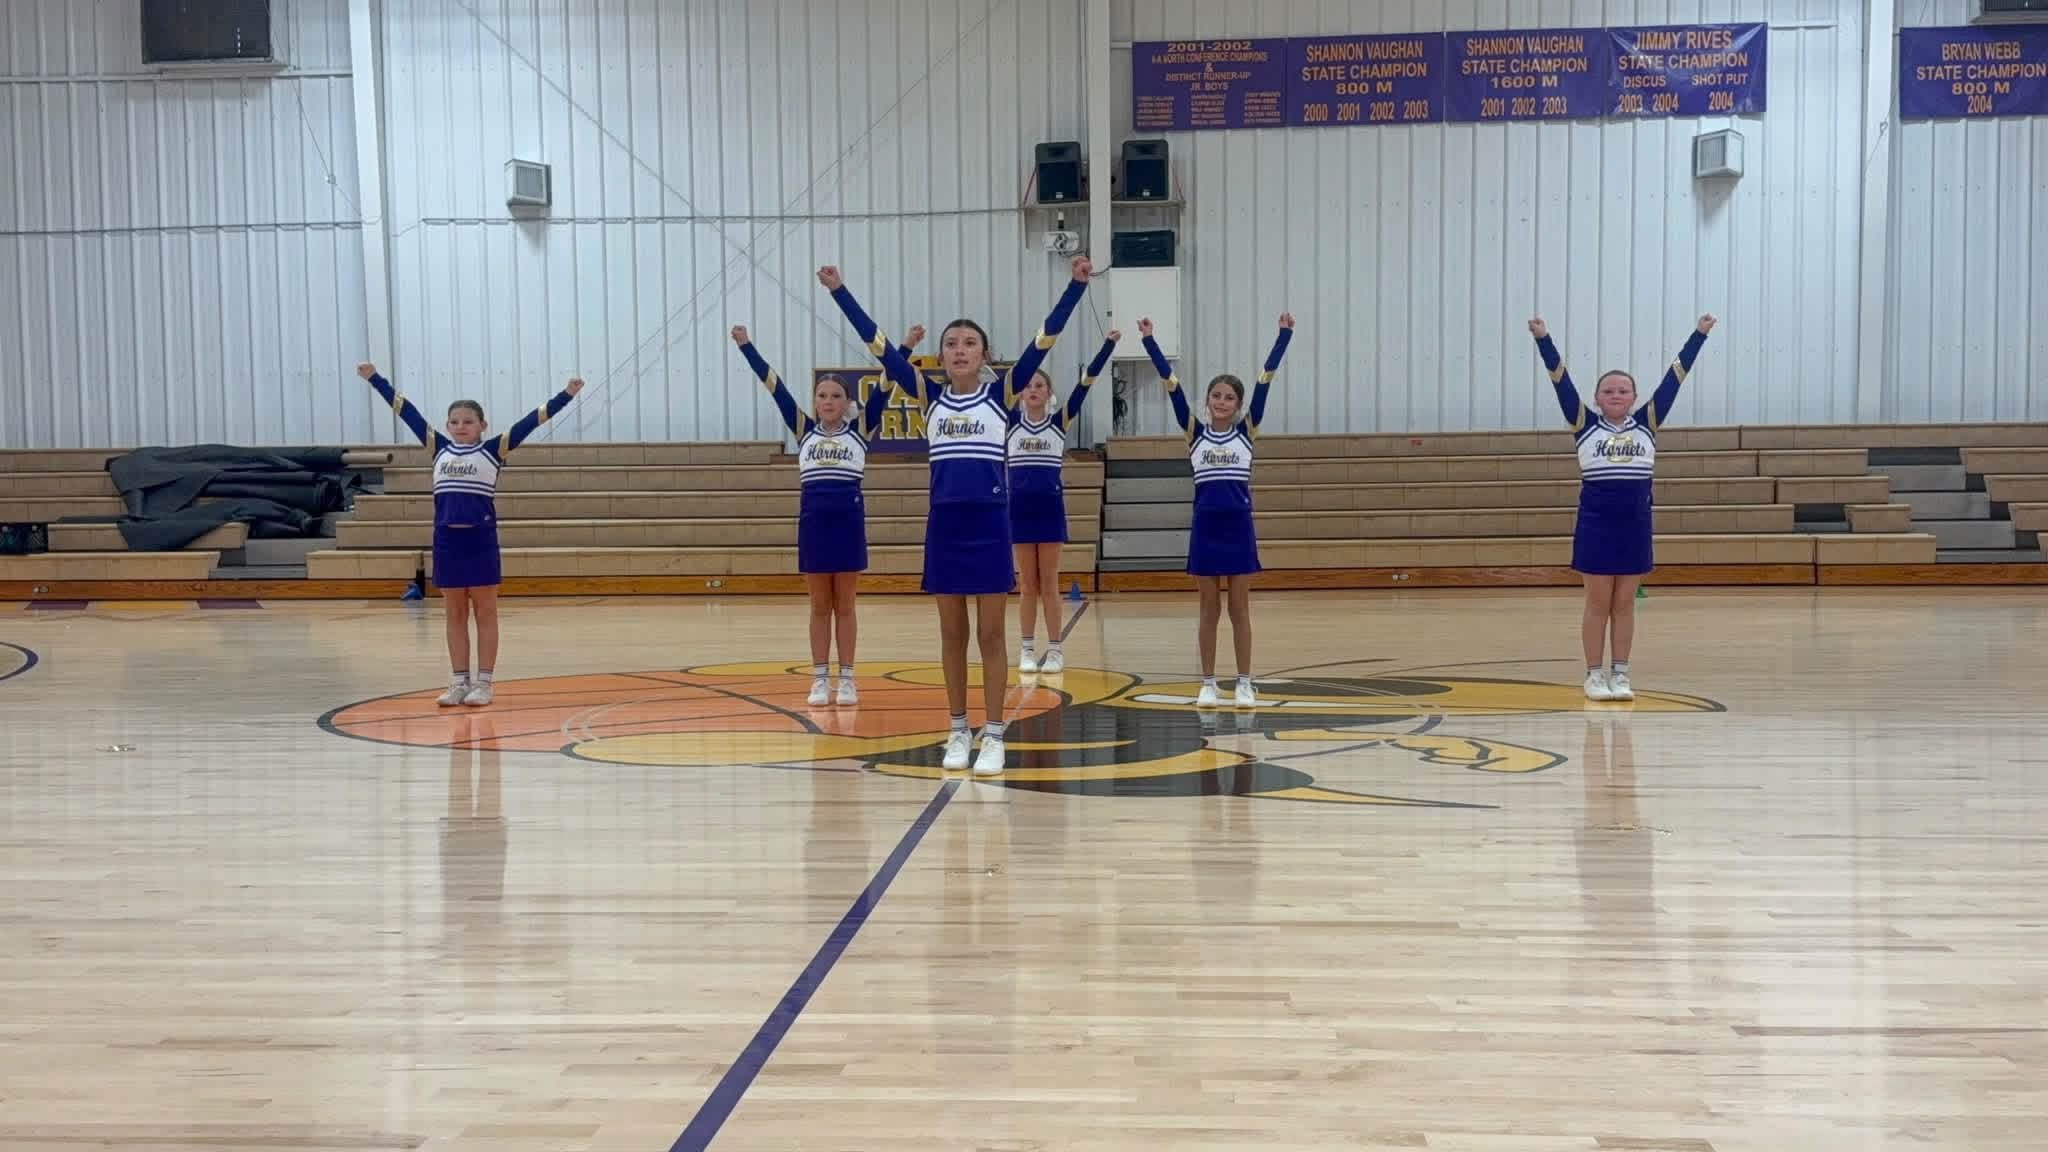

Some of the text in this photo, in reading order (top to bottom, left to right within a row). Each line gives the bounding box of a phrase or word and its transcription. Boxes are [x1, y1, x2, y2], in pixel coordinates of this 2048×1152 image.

[1168, 41, 1251, 52] 2001-2002
[1466, 35, 1584, 56] SHANNON VAUGHAN
[1632, 30, 1732, 51] JIMMY RIVES
[1186, 52, 1229, 63] CONFERENCE
[1306, 40, 1424, 63] SHANNON VAUGHAN
[1942, 42, 2020, 60] BRYAN WEBB
[1205, 63, 1213, 72] &
[1462, 57, 1588, 75] STATE CHAMPION
[1618, 52, 1748, 70] STATE CHAMPION
[1166, 72, 1250, 81] DISTRICT RUNNER-UP
[1302, 62, 1428, 81] STATE CHAMPION
[1692, 74, 1748, 86] SHOT PUT
[1916, 63, 2046, 80] STATE CHAMPION
[1205, 82, 1228, 90] BOYS
[1336, 81, 1392, 94] 800 M
[1491, 75, 1558, 88] 1600 M
[1624, 74, 1666, 88] DISCUS
[1952, 82, 2010, 96] 800 M
[1480, 96, 1567, 117] 2001 2002 2003
[1618, 94, 1680, 113] 2003 2004
[1708, 92, 1734, 111] 2004
[1968, 96, 1992, 114] 2004
[1304, 100, 1428, 122] 2000 2001 2002 2003
[936, 418, 985, 436] Hornets
[804, 444, 854, 462] Hornets
[1017, 438, 1051, 450] Hornets
[1593, 439, 1646, 458] Hornets
[1200, 450, 1240, 464] Hornets
[439, 460, 478, 476] Hornets
